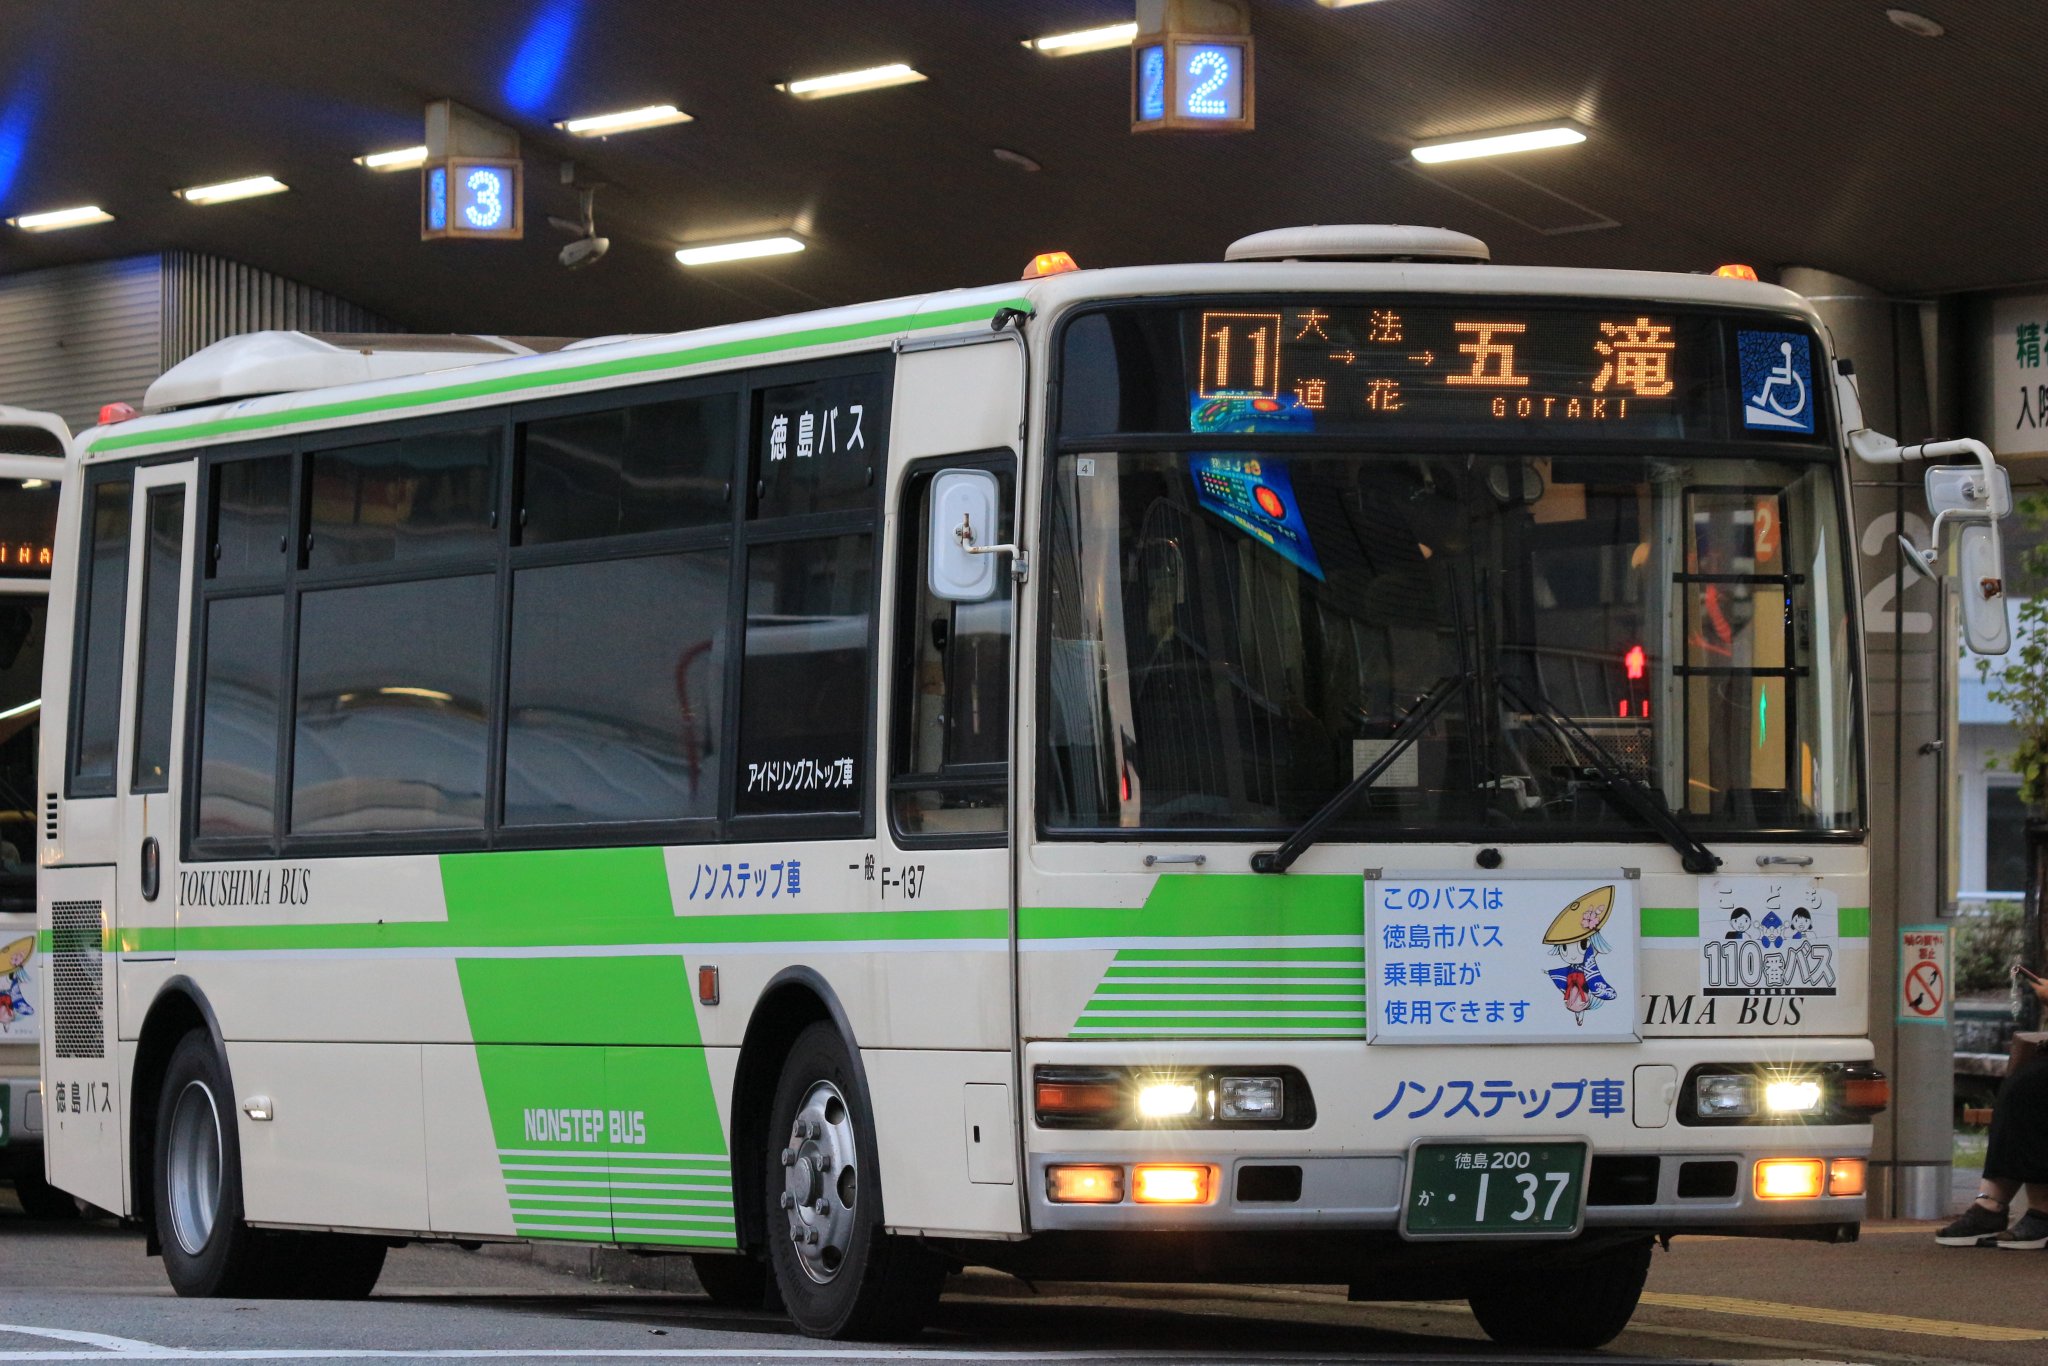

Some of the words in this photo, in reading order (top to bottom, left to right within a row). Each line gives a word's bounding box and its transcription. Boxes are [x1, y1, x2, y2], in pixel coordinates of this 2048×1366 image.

[1188, 51, 1228, 114] 2
[466, 170, 501, 227] 3
[1210, 325, 1268, 388] 11
[1446, 317, 1676, 396] 五滝
[1491, 397, 1627, 419] GOTAKI
[770, 404, 865, 462] 徳島バス
[1861, 510, 1933, 634] 2
[747, 756, 854, 793] アイドリングストップ車
[689, 859, 801, 901] ノンステップ車
[849, 853, 875, 881] 一般
[881, 864, 926, 901] F-137
[179, 869, 271, 907] TOKUSHIMA
[278, 867, 311, 905] BUS
[1384, 886, 1504, 911] このバスは
[1382, 923, 1504, 950] 徳島市バス
[1383, 962, 1482, 987] 乗車証が
[1703, 940, 1837, 988] 110番バス
[1384, 1000, 1531, 1026] 使用できます
[1641, 994, 1717, 1026] IMA
[1737, 997, 1805, 1026] BUS
[55, 1080, 112, 1115] 徳島バス
[1372, 1078, 1627, 1121] ノンステップ車
[523, 1108, 604, 1143] NONSTEP
[608, 1109, 646, 1145] BUS
[1417, 1190, 1435, 1207] か
